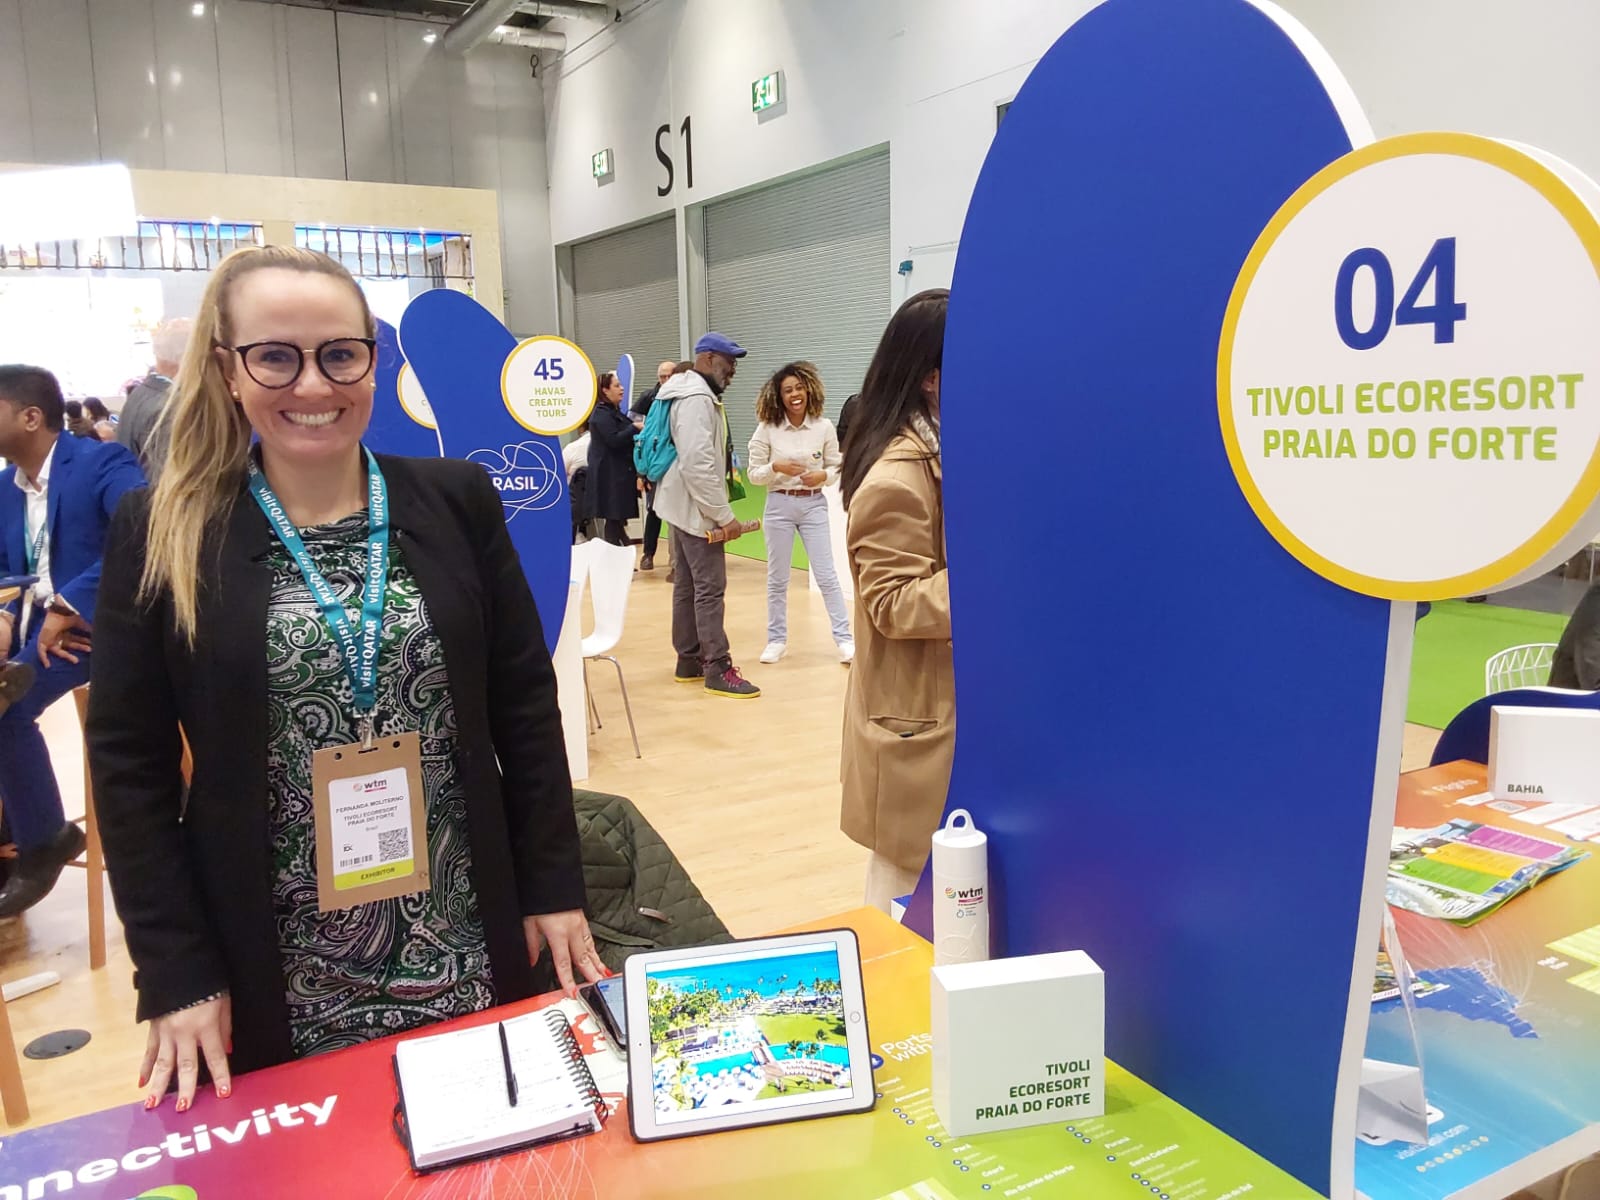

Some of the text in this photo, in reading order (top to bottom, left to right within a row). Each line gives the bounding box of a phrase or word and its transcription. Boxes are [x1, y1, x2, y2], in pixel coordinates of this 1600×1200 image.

[655, 114, 693, 197] S1
[1334, 236, 1467, 350] 04
[533, 357, 565, 381] 45
[534, 386, 566, 396] HAVAS
[1246, 373, 1584, 417] TIVOLI ECORESORT
[528, 397, 573, 407] CREATIVE
[536, 409, 567, 418] TOURS
[1263, 426, 1557, 461] PRAIA DO FORTE
[492, 475, 540, 491] RASIL
[364, 779, 387, 789] wtm
[1507, 783, 1544, 794] BAHIA
[335, 795, 405, 814] FERNANDA MOLITERNO
[344, 805, 398, 822] TIVOLI ECORESORT
[347, 812, 395, 827] PRAIA DO FORTE
[360, 866, 396, 881] EXHIBITOR
[957, 887, 984, 899] wtm
[1045, 1058, 1091, 1076] TIVOLI
[1009, 1075, 1091, 1098] ECORESORT
[975, 1092, 1091, 1120] PRAIA DO FORTE
